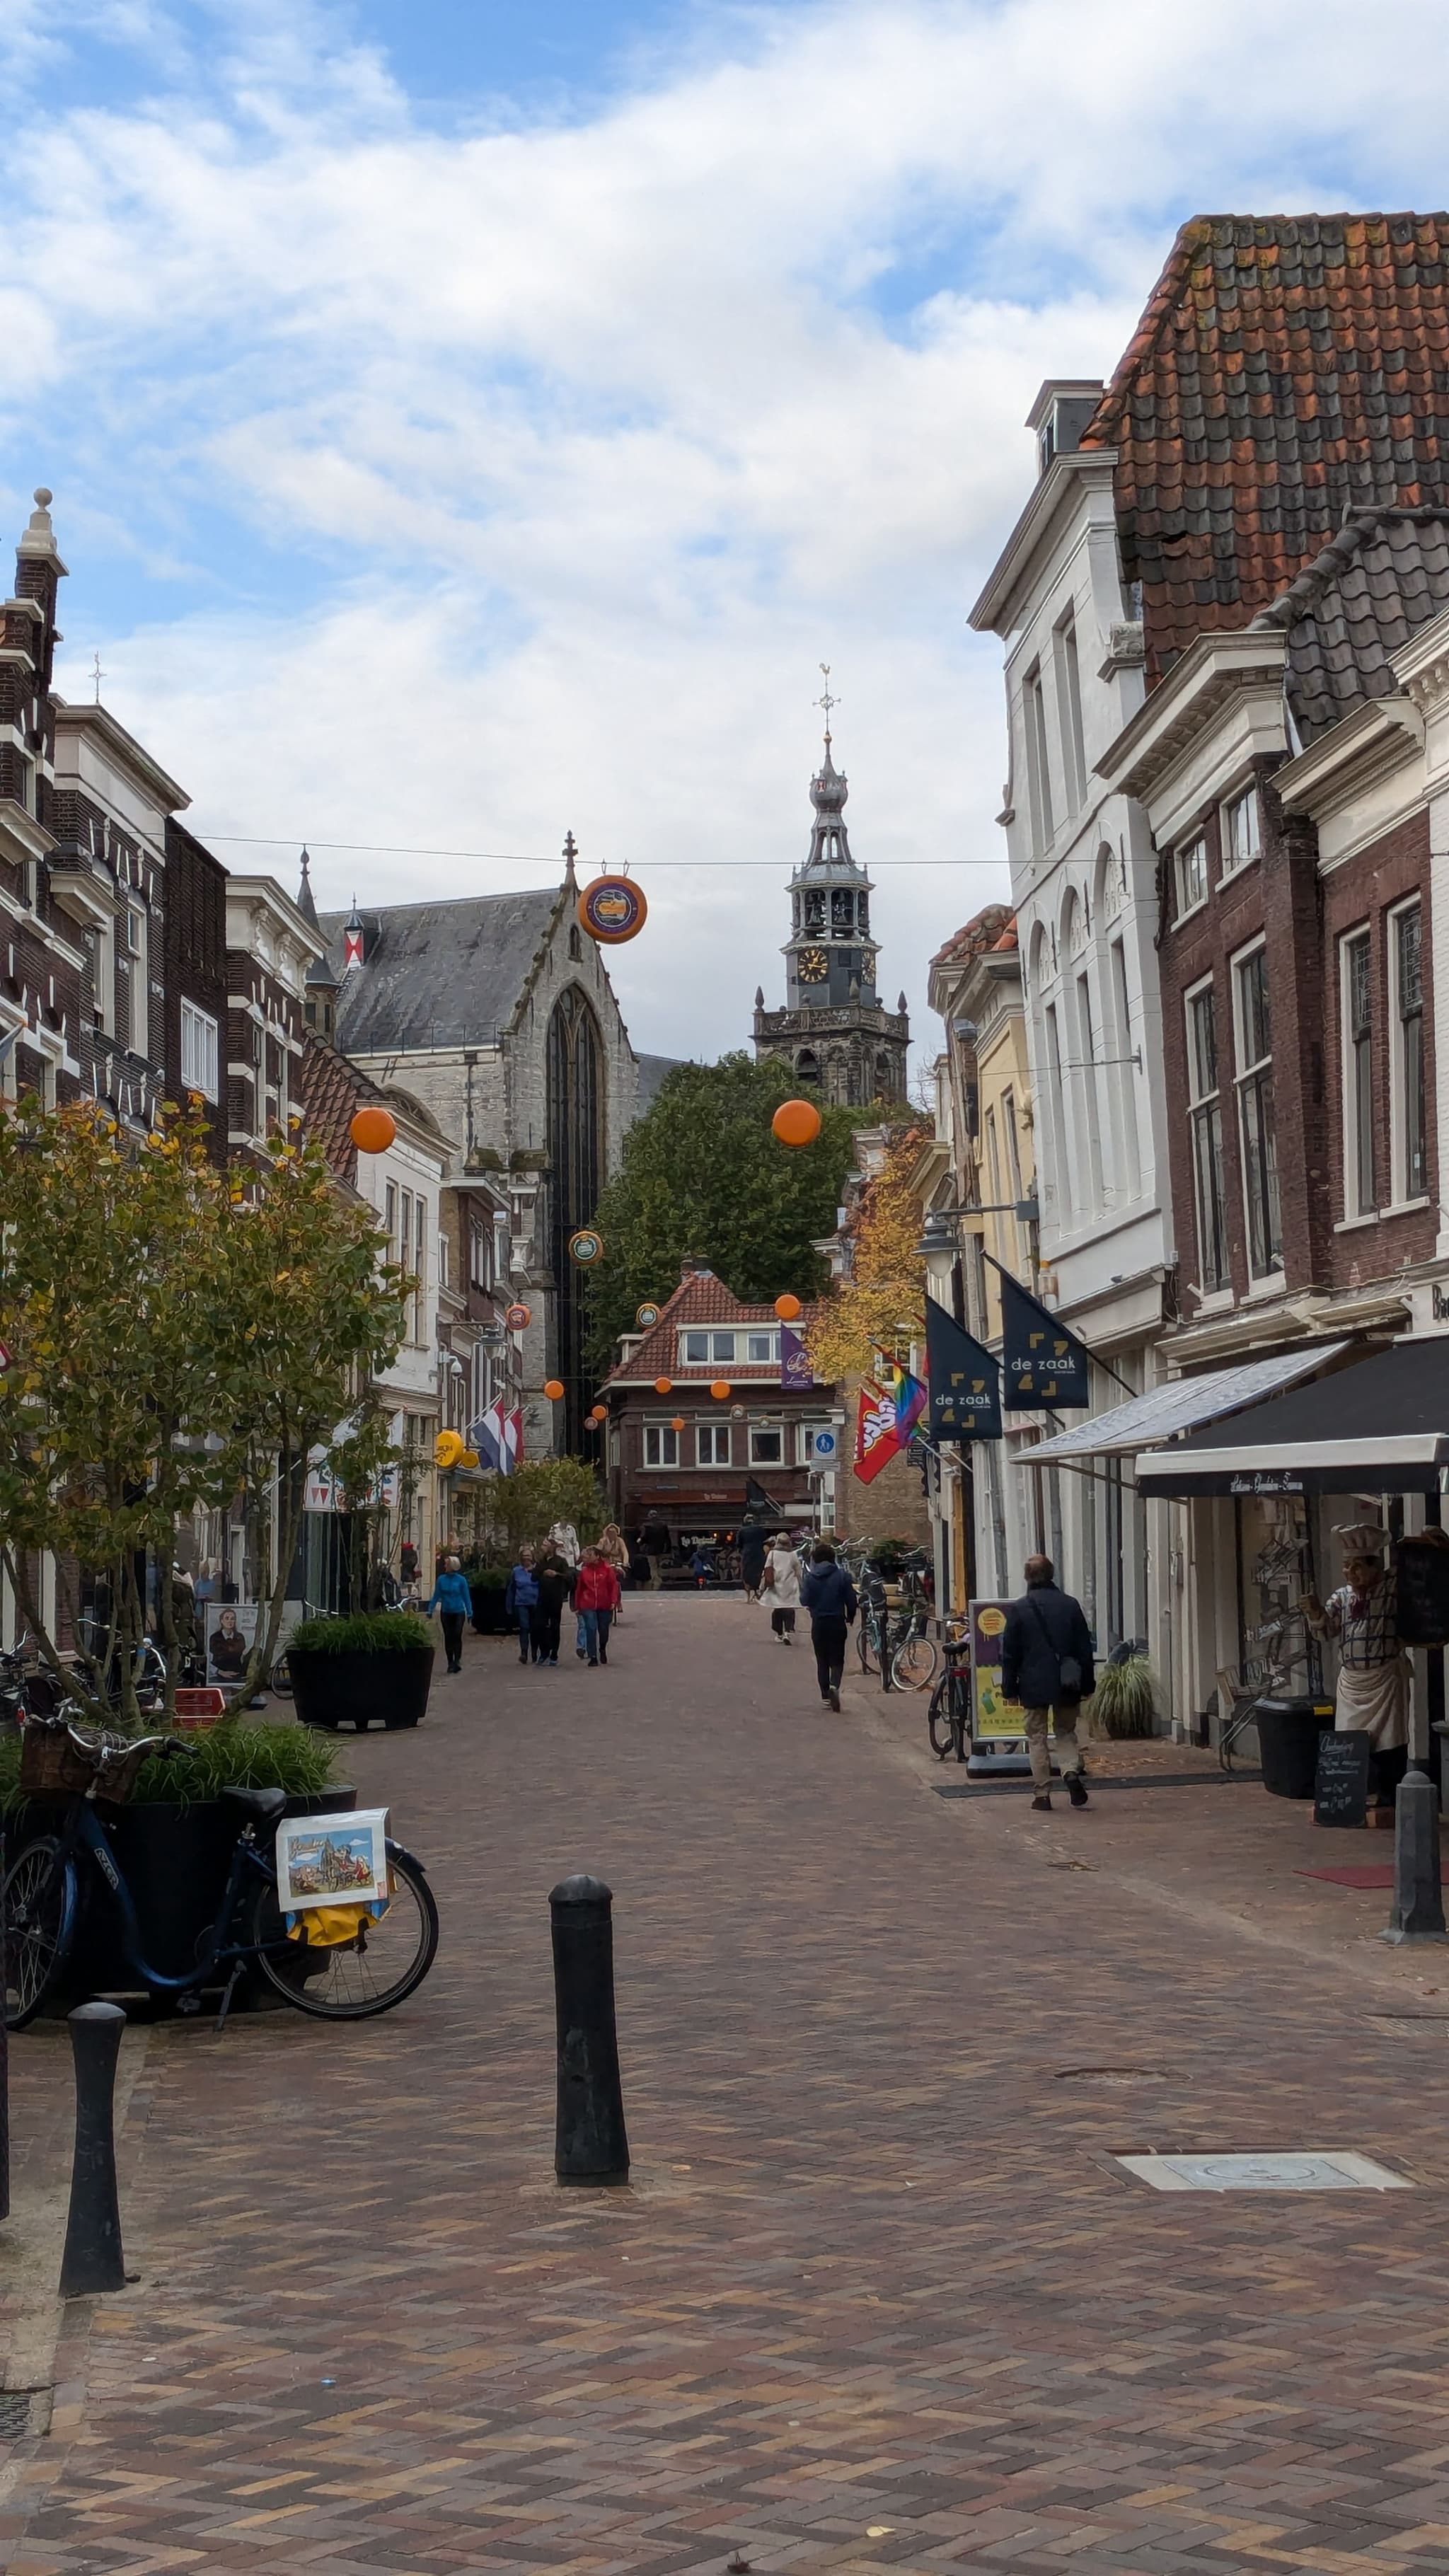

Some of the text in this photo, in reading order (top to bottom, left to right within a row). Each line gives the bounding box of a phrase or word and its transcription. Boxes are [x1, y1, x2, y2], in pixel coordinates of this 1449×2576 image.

[1012, 1356, 1076, 1370] de zaak
[935, 1392, 991, 1405] de zaak
